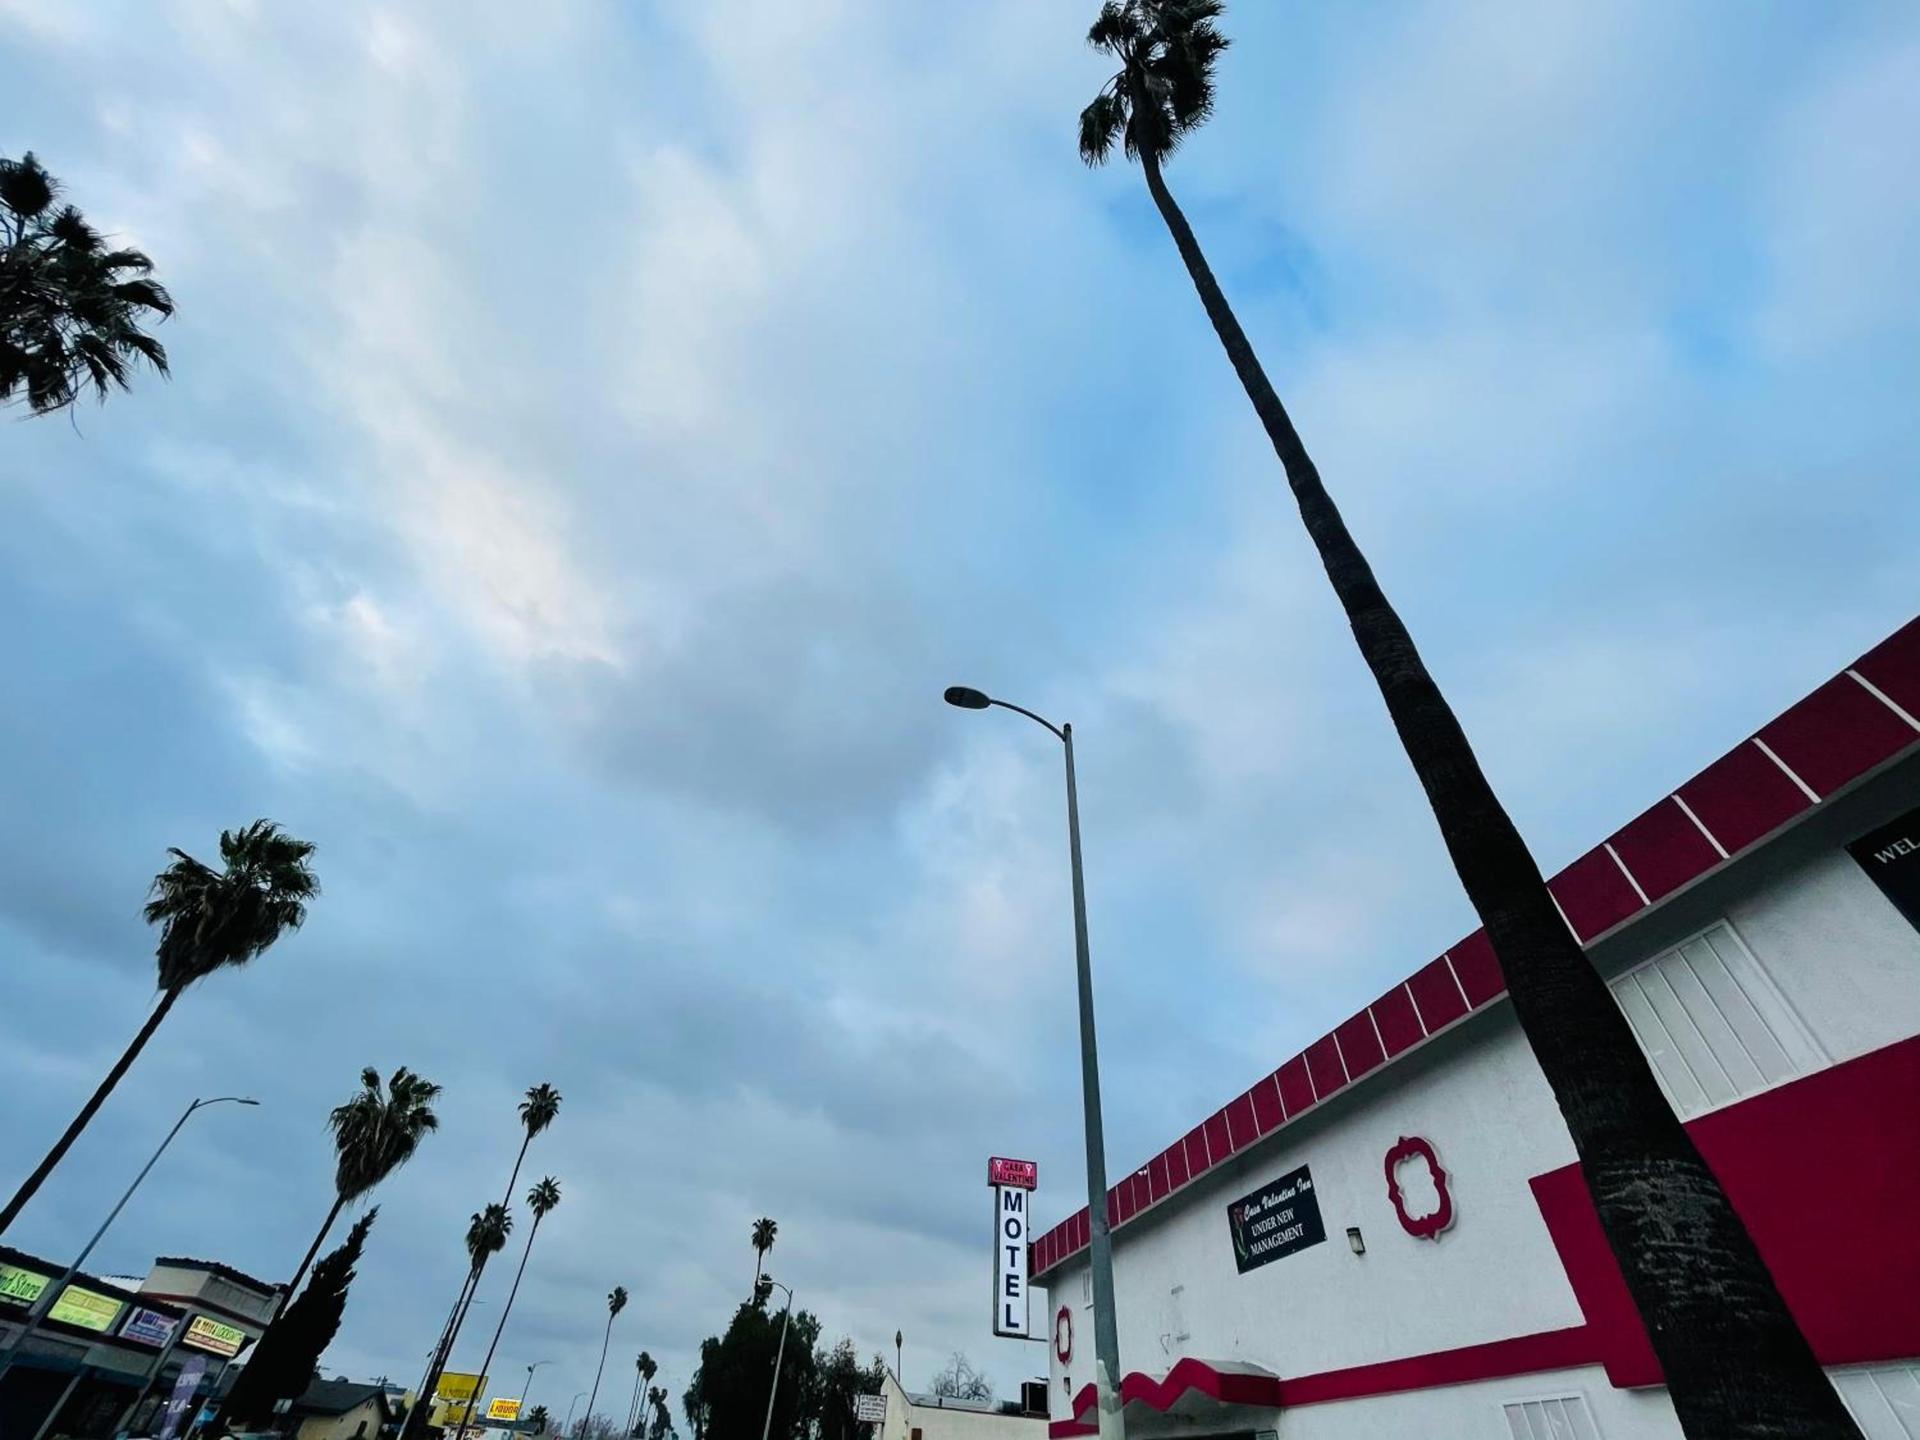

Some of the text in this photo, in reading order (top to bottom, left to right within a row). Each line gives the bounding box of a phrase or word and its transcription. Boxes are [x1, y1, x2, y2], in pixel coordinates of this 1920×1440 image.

[994, 1170, 1034, 1186] VALENTINE
[1004, 1162, 1024, 1173] CASA
[1243, 1177, 1312, 1221] Casa Valentine Inn
[1251, 1207, 1295, 1237] UNDER NEW
[1249, 1223, 1305, 1256] MANAGEMENT
[1004, 1191, 1022, 1327] MOTEL
[10, 1273, 41, 1299] Store
